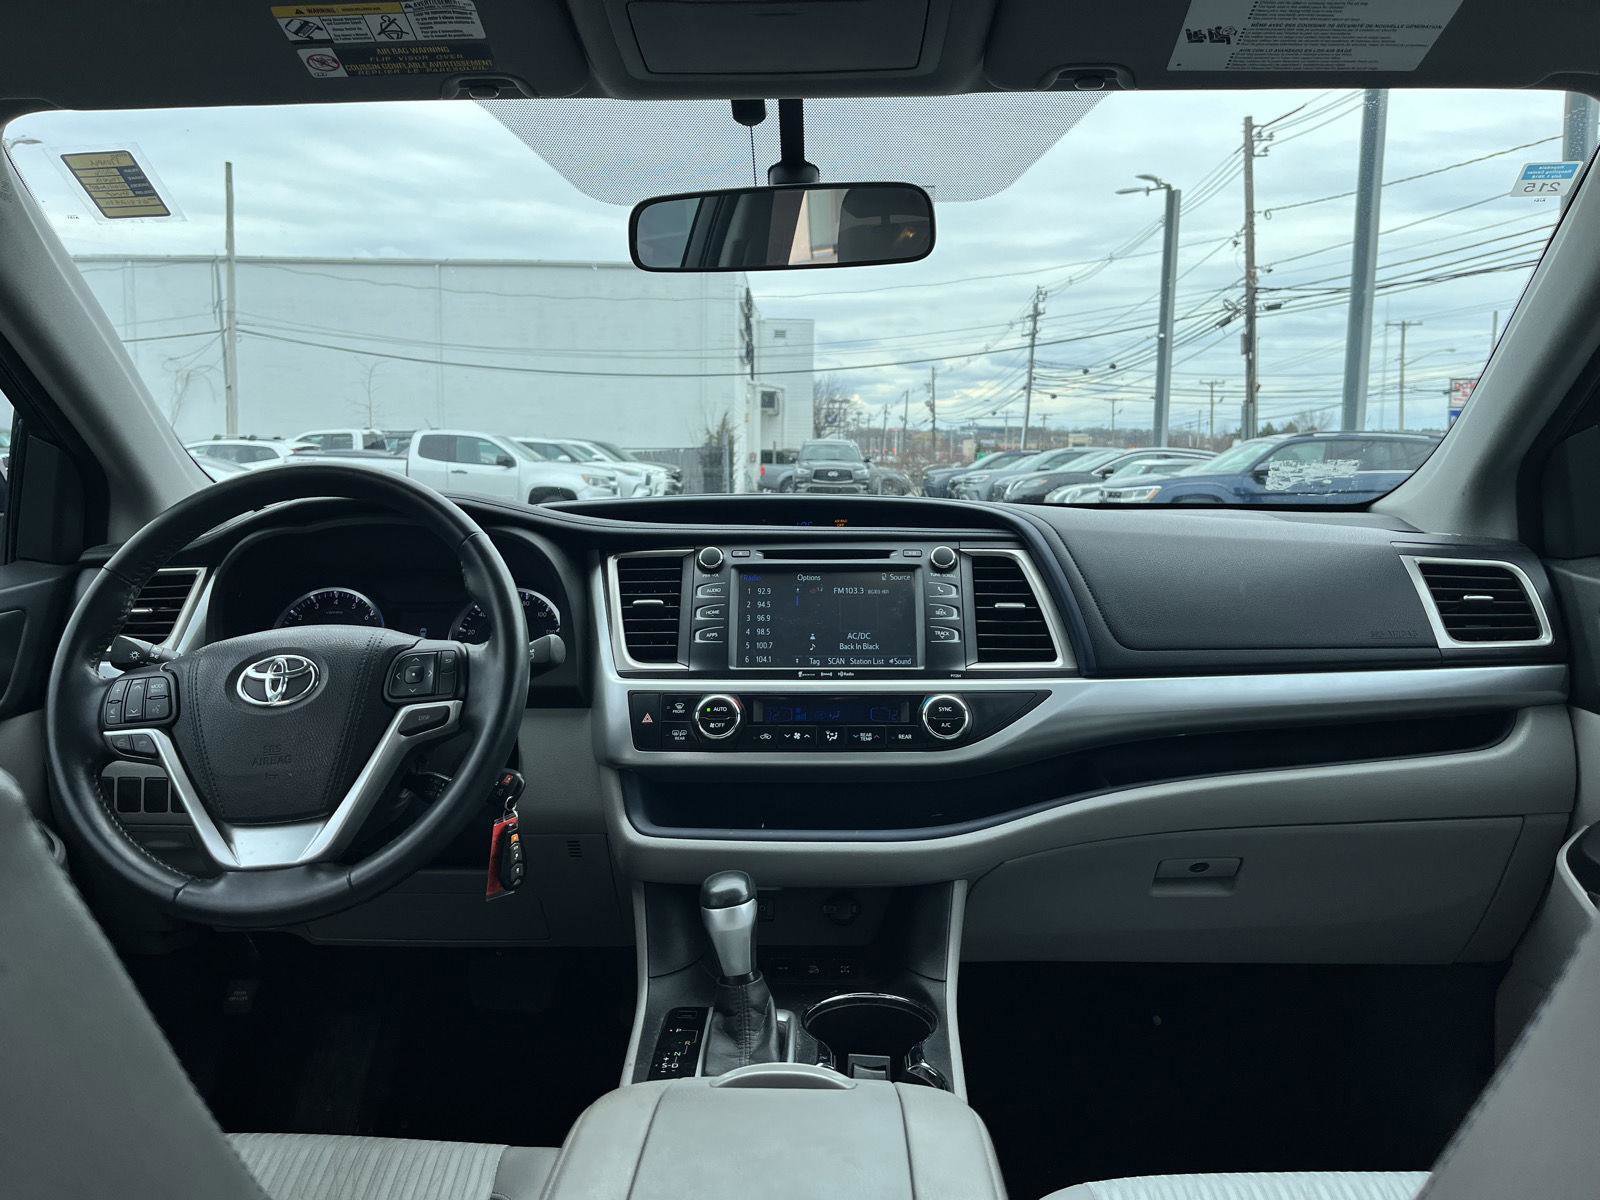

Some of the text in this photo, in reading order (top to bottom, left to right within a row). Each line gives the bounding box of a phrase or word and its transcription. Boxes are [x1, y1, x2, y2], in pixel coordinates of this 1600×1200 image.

[797, 573, 822, 582] Options
[889, 573, 911, 581] Source
[747, 587, 772, 595] 1 92.9
[746, 600, 751, 608] 2
[756, 614, 771, 622] 96.9
[745, 628, 771, 636] 4 98.5
[847, 632, 872, 640] AC/DC
[756, 641, 773, 649] 100.7
[839, 642, 855, 650] Back
[863, 642, 880, 650] Black
[809, 657, 821, 666] Tag
[827, 657, 846, 665] SCAN
[849, 657, 872, 665] Station
[894, 657, 912, 665] Sound
